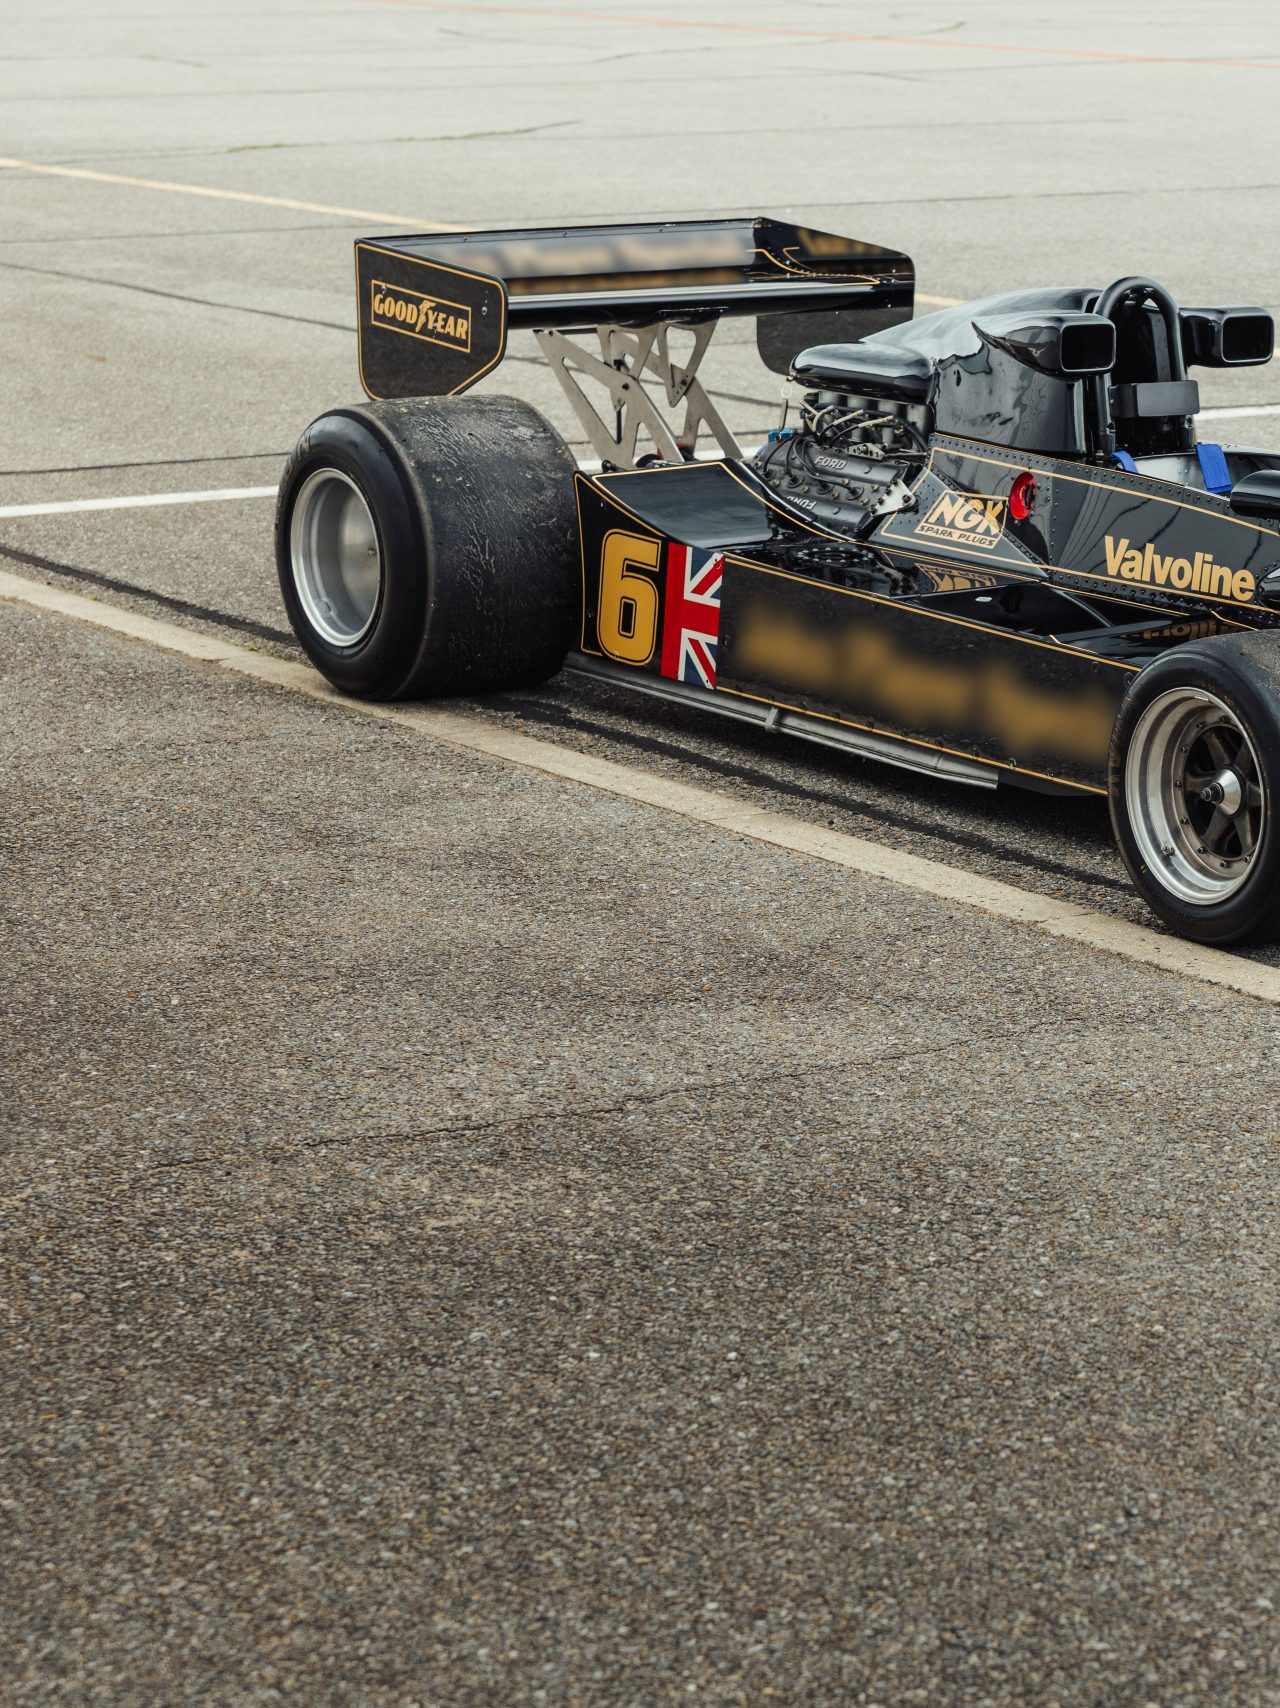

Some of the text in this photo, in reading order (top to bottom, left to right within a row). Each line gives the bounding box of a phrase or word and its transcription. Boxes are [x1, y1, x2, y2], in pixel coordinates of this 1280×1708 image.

[374, 293, 469, 340] GOODYEAR
[814, 455, 848, 470] FORD
[918, 525, 996, 547] SPARK PLUGS
[927, 494, 1004, 536] NGK
[1104, 535, 1256, 602] Valvoline
[597, 528, 662, 666] 6
